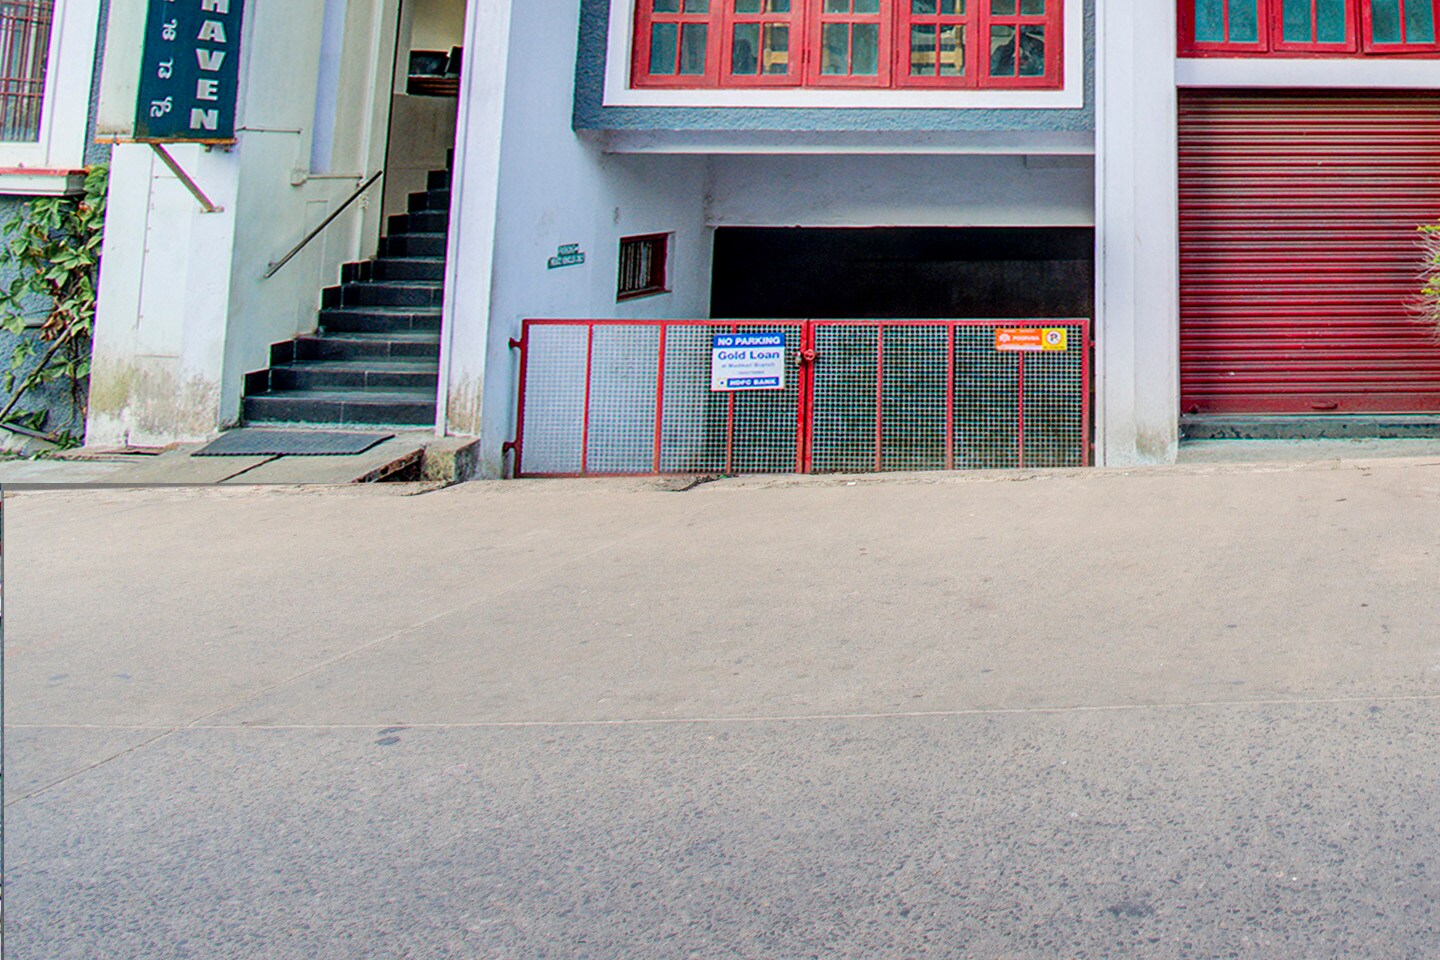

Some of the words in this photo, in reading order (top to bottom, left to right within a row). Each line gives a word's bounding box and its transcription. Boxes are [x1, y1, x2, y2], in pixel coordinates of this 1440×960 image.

[717, 337, 733, 346] NO
[735, 336, 781, 346] PARKING
[718, 351, 746, 360] Gold
[750, 351, 780, 360] Loan
